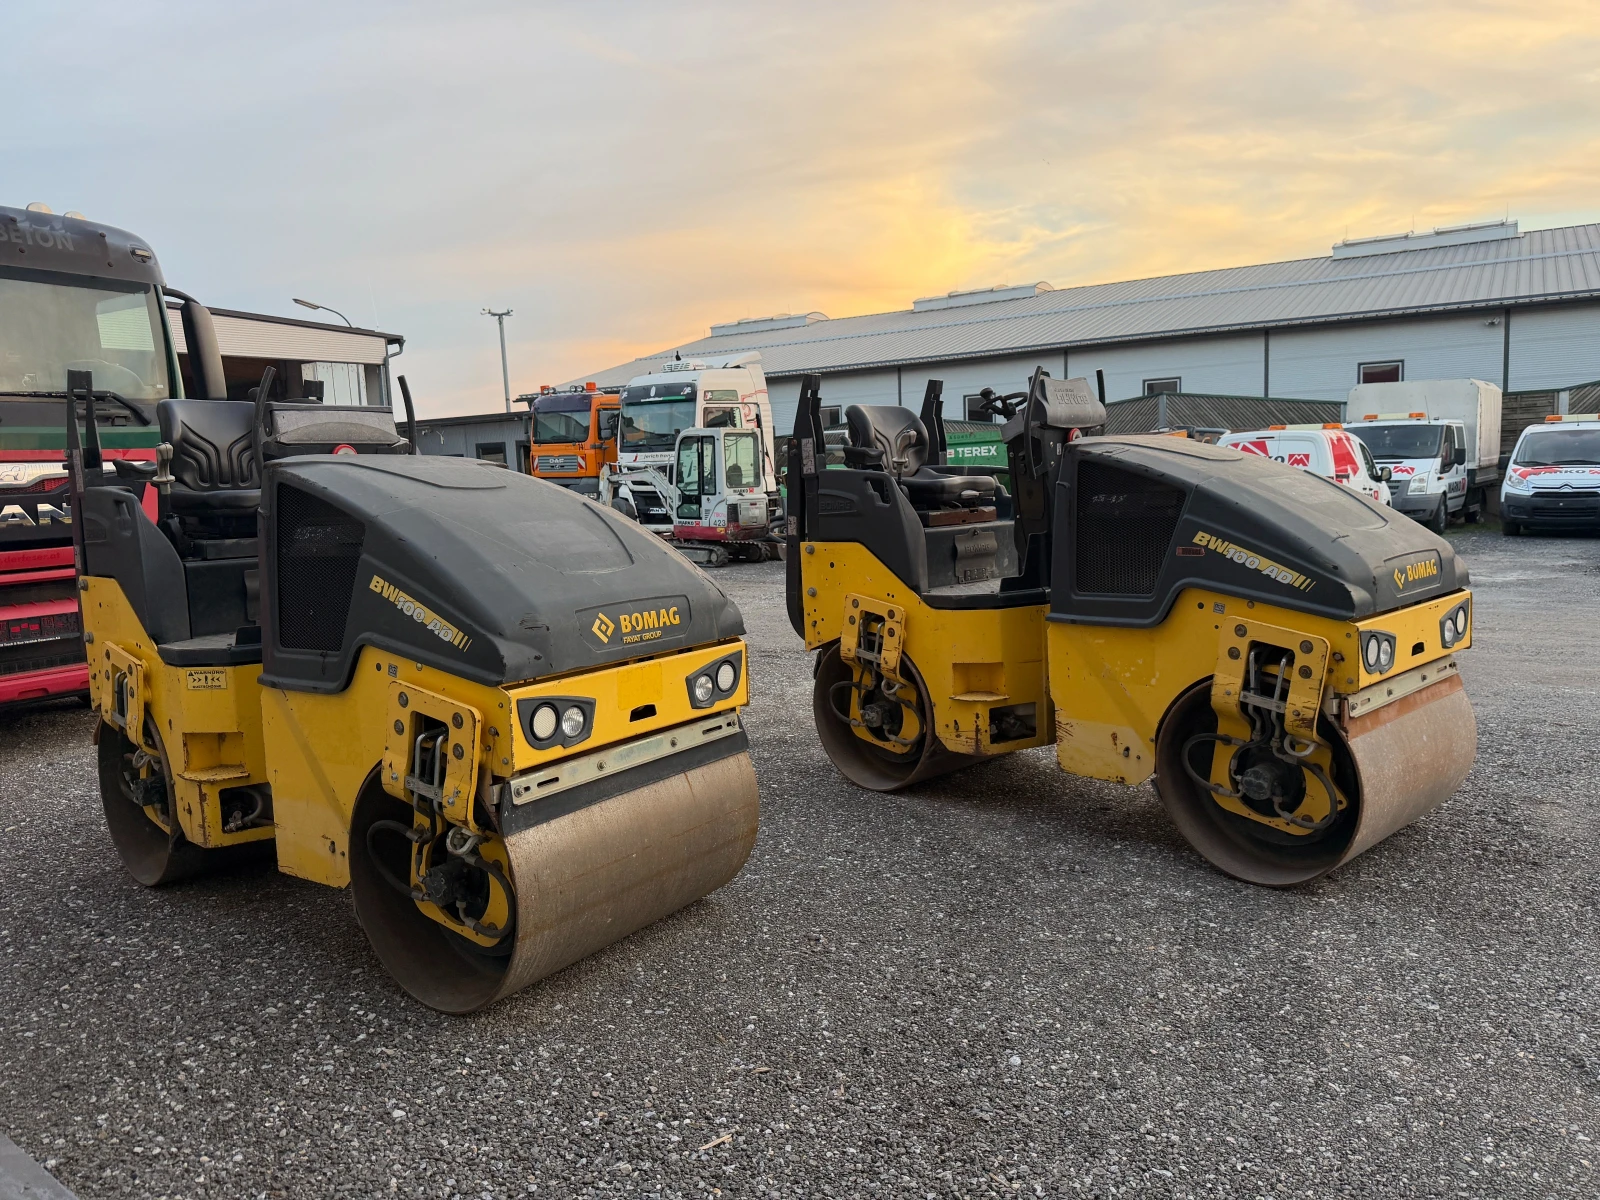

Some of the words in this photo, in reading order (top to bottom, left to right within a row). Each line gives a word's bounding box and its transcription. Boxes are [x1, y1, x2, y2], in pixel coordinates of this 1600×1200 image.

[956, 445, 997, 457] TEREX
[713, 519, 726, 527] 423
[1406, 559, 1437, 582] BOMAG
[619, 606, 680, 633] BOMAG
[622, 634, 641, 644] FAYAT
[642, 630, 662, 641] GROUP
